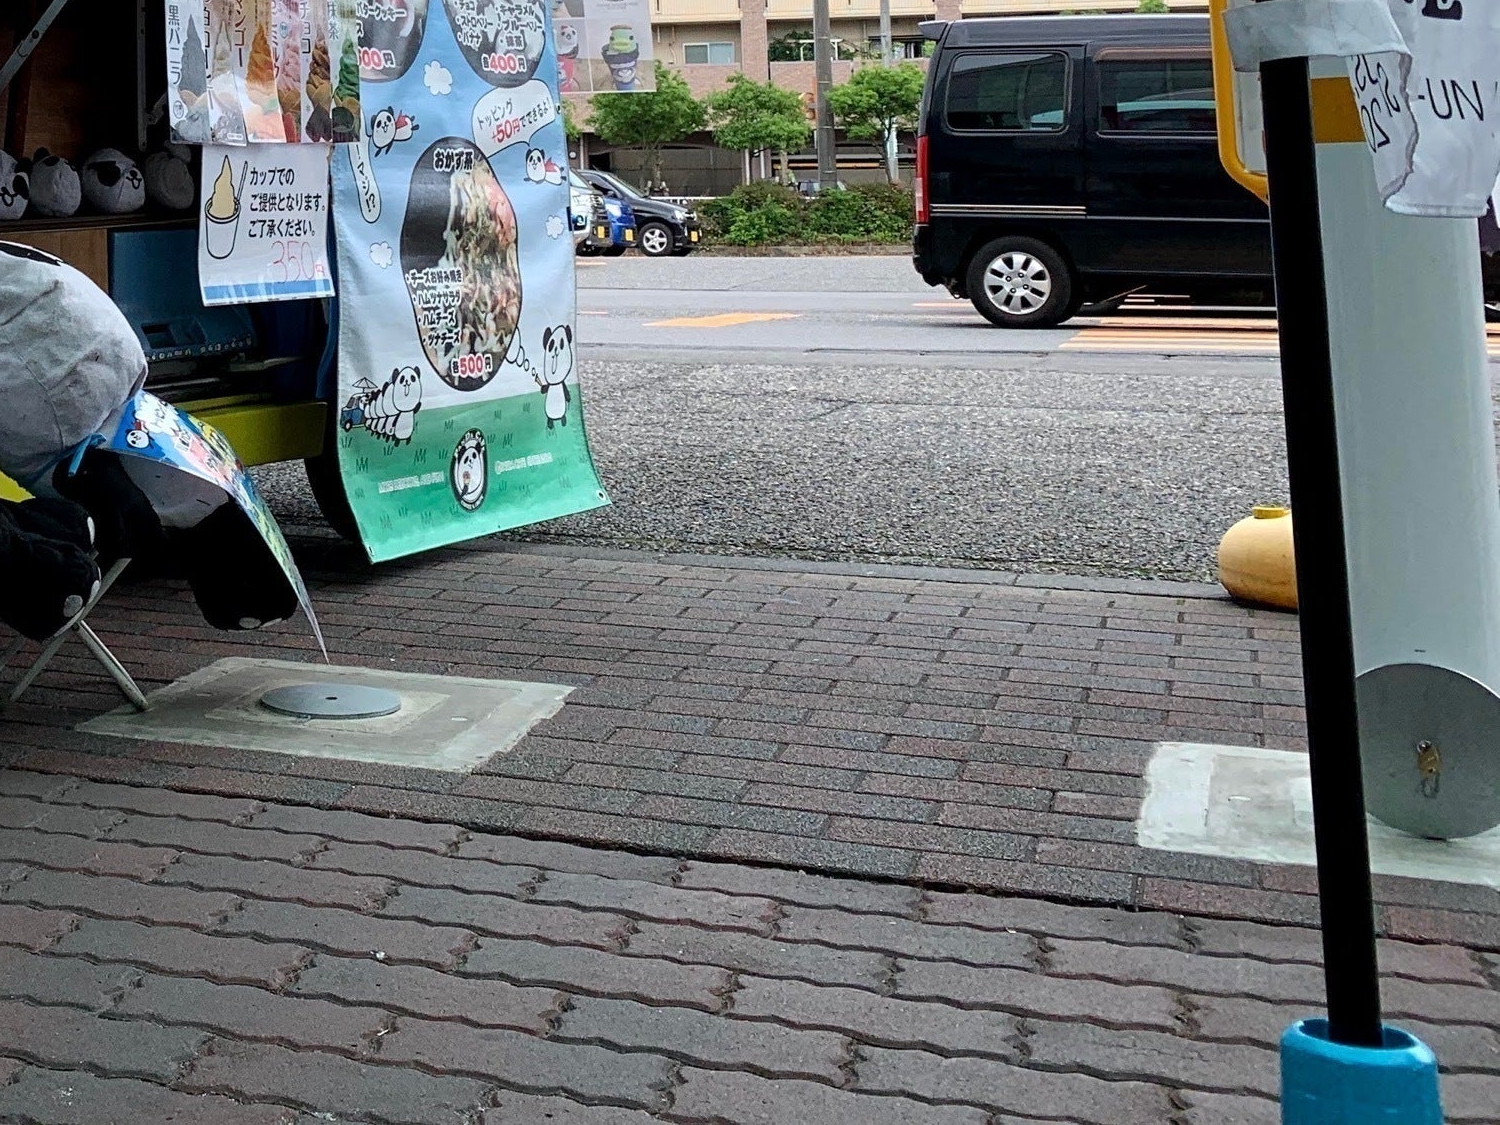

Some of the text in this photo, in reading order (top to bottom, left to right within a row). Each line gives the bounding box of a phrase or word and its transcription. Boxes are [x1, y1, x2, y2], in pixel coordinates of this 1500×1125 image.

[458, 0, 476, 12] チョコ
[499, 3, 535, 17] キャラメル
[461, 14, 494, 27] ストロベリー
[501, 18, 545, 32] ブルーベリー
[462, 31, 482, 48] バナナ
[505, 35, 524, 48] 抹茶
[358, 47, 395, 68] 00円
[482, 54, 526, 73] 各400円
[1417, 78, 1485, 121] UN
[476, 98, 513, 130] トッピング
[434, 149, 474, 171] おかず系
[249, 167, 295, 187] カップでの
[250, 192, 326, 213] ご提供となります。
[248, 219, 316, 239] ご了承ください。
[410, 269, 462, 287] チーズお好み焼き
[417, 290, 461, 305] ハムツナサラダ
[422, 311, 457, 326] ハムチーズ
[428, 331, 461, 346] ツナチーズ
[452, 354, 492, 374] 各500円
